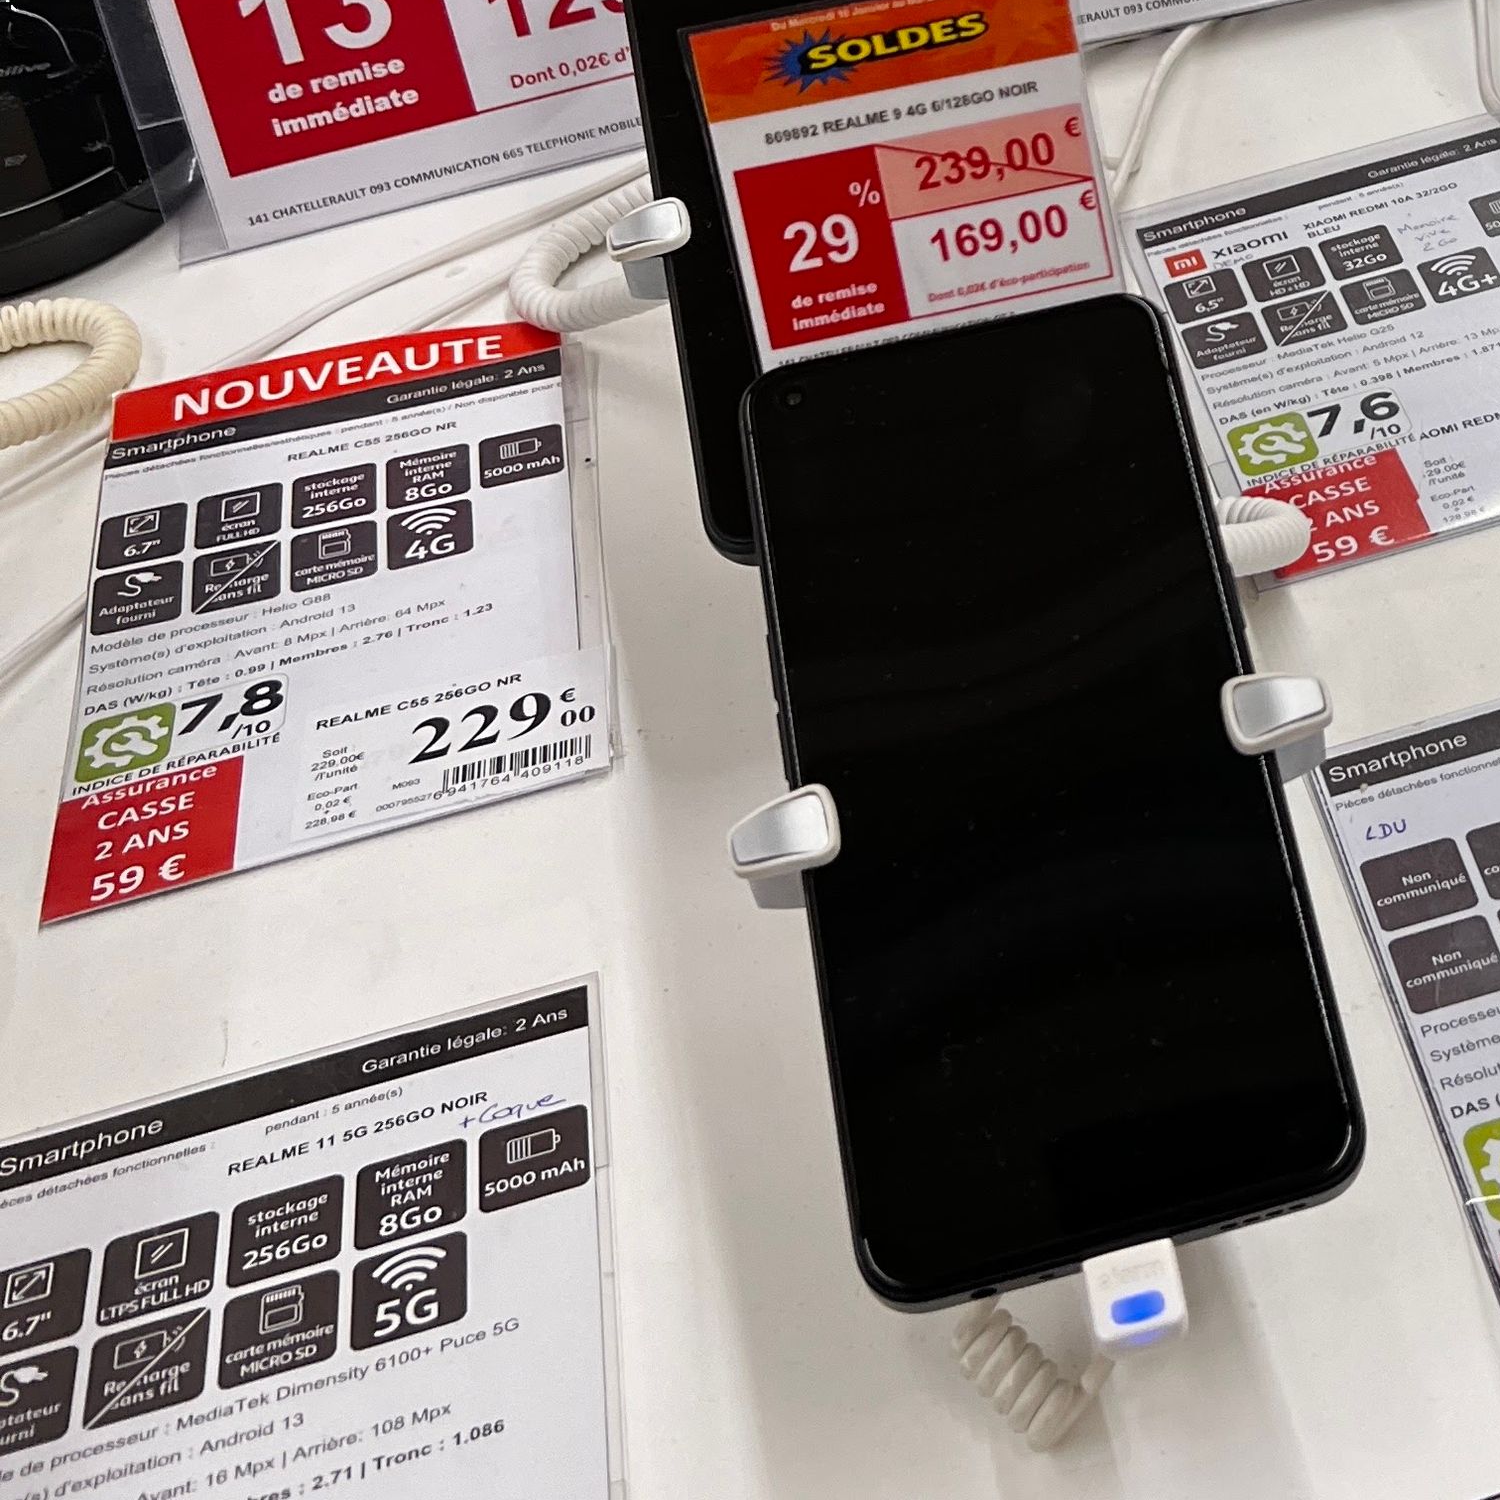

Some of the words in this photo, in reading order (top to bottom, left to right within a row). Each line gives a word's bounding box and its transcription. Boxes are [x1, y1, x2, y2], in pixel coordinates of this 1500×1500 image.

[806, 13, 986, 69] SOLDES
[268, 80, 302, 103] de
[311, 56, 405, 95] remise
[271, 86, 419, 138] immédiate
[765, 124, 819, 145] 869892
[823, 109, 889, 133] REALME
[894, 107, 902, 121] 9
[906, 102, 927, 118] 4G
[931, 91, 994, 112] 6/128GO
[999, 81, 1038, 98] NOIR
[915, 132, 1054, 191] 239,00
[783, 214, 860, 273] 29
[931, 205, 1068, 263] 169,00
[1342, 252, 1388, 271] 32Go
[1438, 271, 1498, 300] 4G+
[174, 336, 502, 420] NOUVEAUTE
[1307, 391, 1400, 439] 7,6
[112, 425, 236, 459] Smartphone
[484, 458, 523, 480] 5000
[526, 452, 561, 471] mAh
[302, 494, 366, 518] 256Go
[404, 480, 452, 503] 8Go
[404, 534, 455, 562] 4G
[1313, 534, 1358, 564] 59
[178, 679, 284, 736] 7,8
[235, 719, 271, 741] /10
[408, 692, 552, 765] 229
[1328, 731, 1468, 784] Smartphone
[97, 792, 194, 830] CASSE
[95, 840, 112, 861] 2
[121, 822, 190, 855] ANS
[91, 862, 145, 902] 59
[158, 852, 186, 880] €
[0, 1117, 163, 1177] Smartphone
[228, 1142, 310, 1175] REALME
[317, 1137, 335, 1152] 11
[341, 1126, 368, 1146] 5G
[373, 1107, 435, 1136] 256GO
[440, 1090, 488, 1116] NOIR
[379, 1203, 443, 1237] 8Go
[243, 1232, 328, 1270] 256Go
[374, 1288, 440, 1338] 5G
